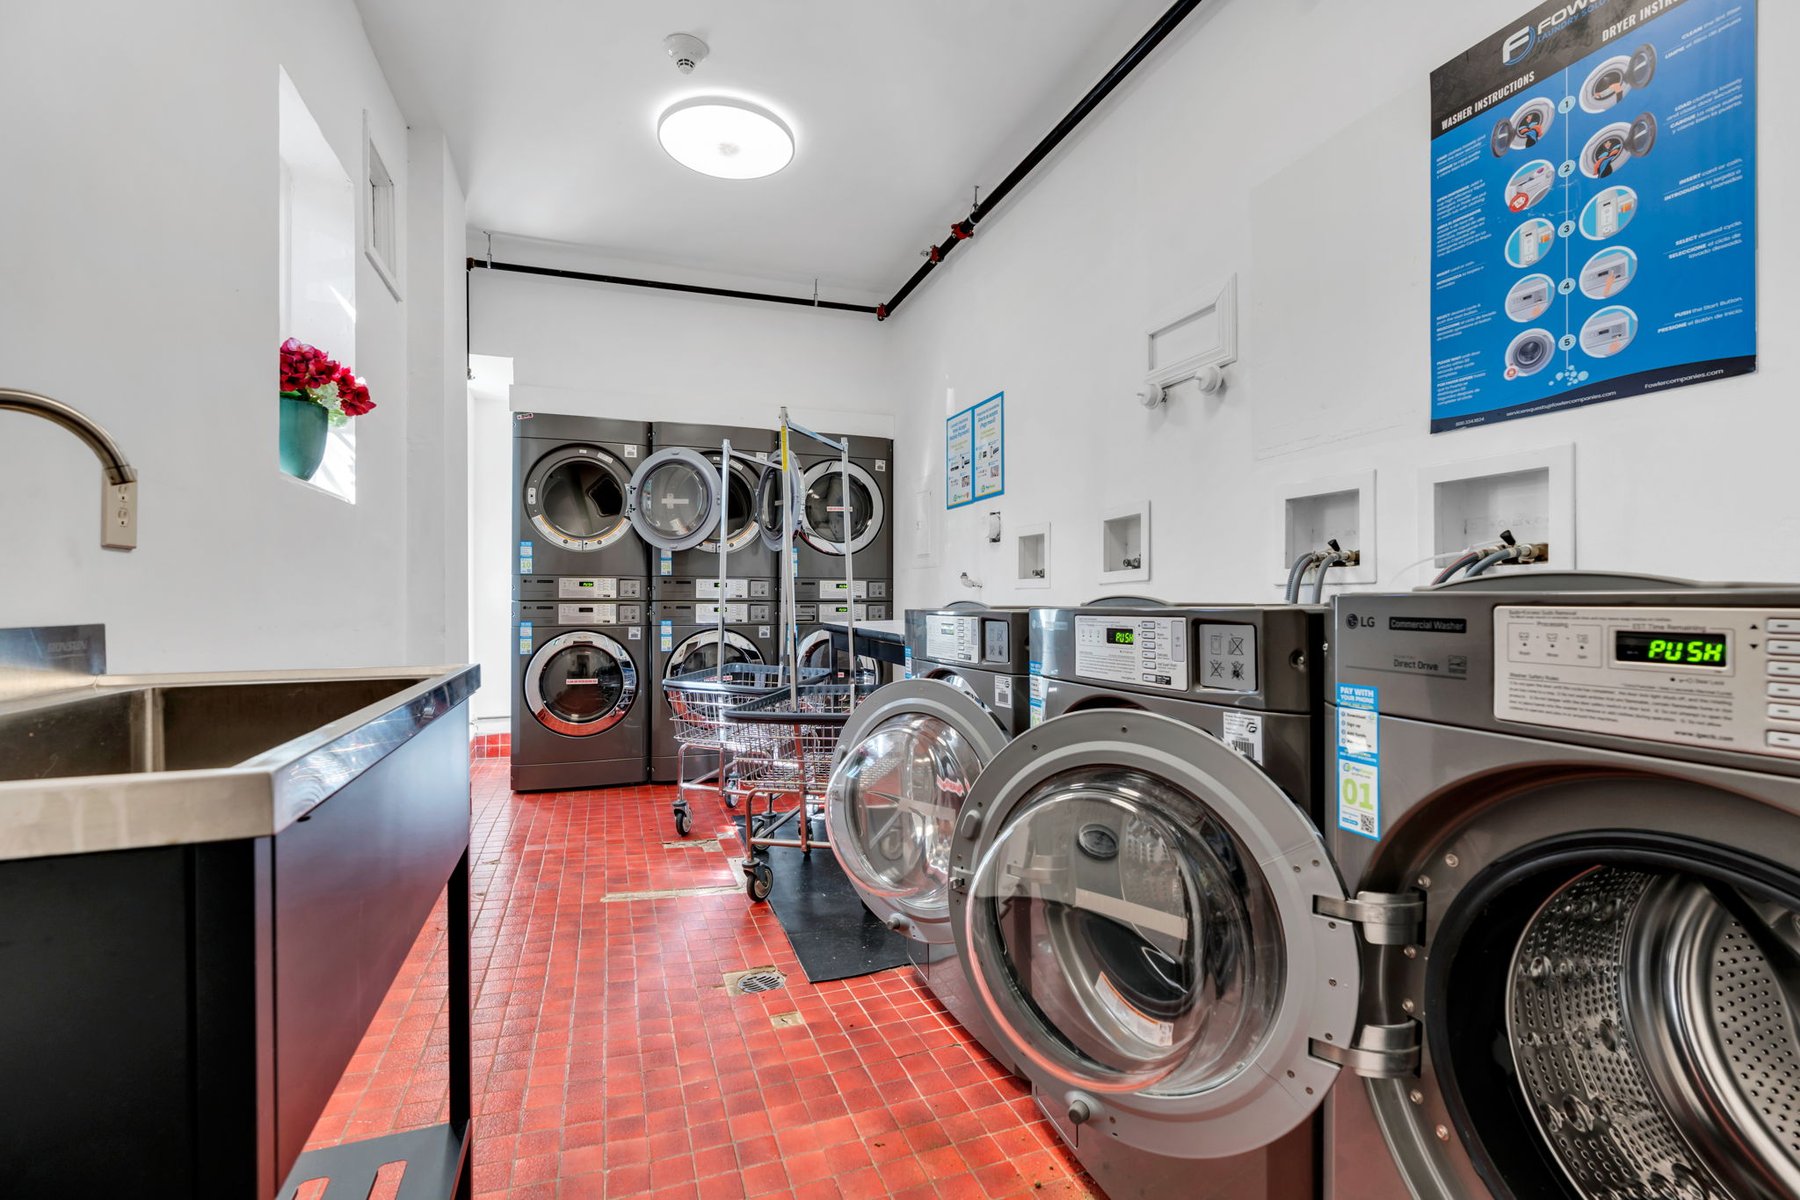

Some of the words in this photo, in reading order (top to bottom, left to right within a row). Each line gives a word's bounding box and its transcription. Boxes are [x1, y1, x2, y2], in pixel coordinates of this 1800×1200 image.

[1602, 14, 1636, 42] DRYER
[1441, 107, 1472, 130] WASHER
[1474, 71, 1535, 113] INSTRUCTIONS
[1674, 100, 1692, 112] LOAD
[1564, 164, 1570, 172] 2
[1679, 173, 1701, 185] INSERT
[1702, 166, 1718, 176] card
[1664, 182, 1705, 201] INTRODUZCA
[1564, 224, 1570, 233] 3
[1676, 234, 1698, 246] SELECT
[1698, 226, 1723, 239] desired
[1668, 244, 1707, 259] SELECCIONE
[1564, 282, 1570, 290] 4
[1674, 308, 1692, 318] PUSH
[1692, 306, 1703, 314] the
[1703, 302, 1719, 310] Start
[1657, 322, 1687, 334] PRESIONE
[1564, 338, 1570, 346] 5
[1360, 616, 1375, 628] LG
[1390, 619, 1432, 629] Commercial
[1434, 621, 1464, 631] Washer
[1667, 625, 1706, 633] Remaining
[1115, 632, 1134, 643] PUSH
[1648, 640, 1722, 662] PUSH
[1393, 659, 1416, 668] Direct
[1417, 661, 1439, 670] Drive
[1340, 686, 1352, 694] PAY
[1355, 689, 1374, 698] WITH
[1356, 696, 1374, 704] PHONE
[1343, 778, 1373, 811] 01
